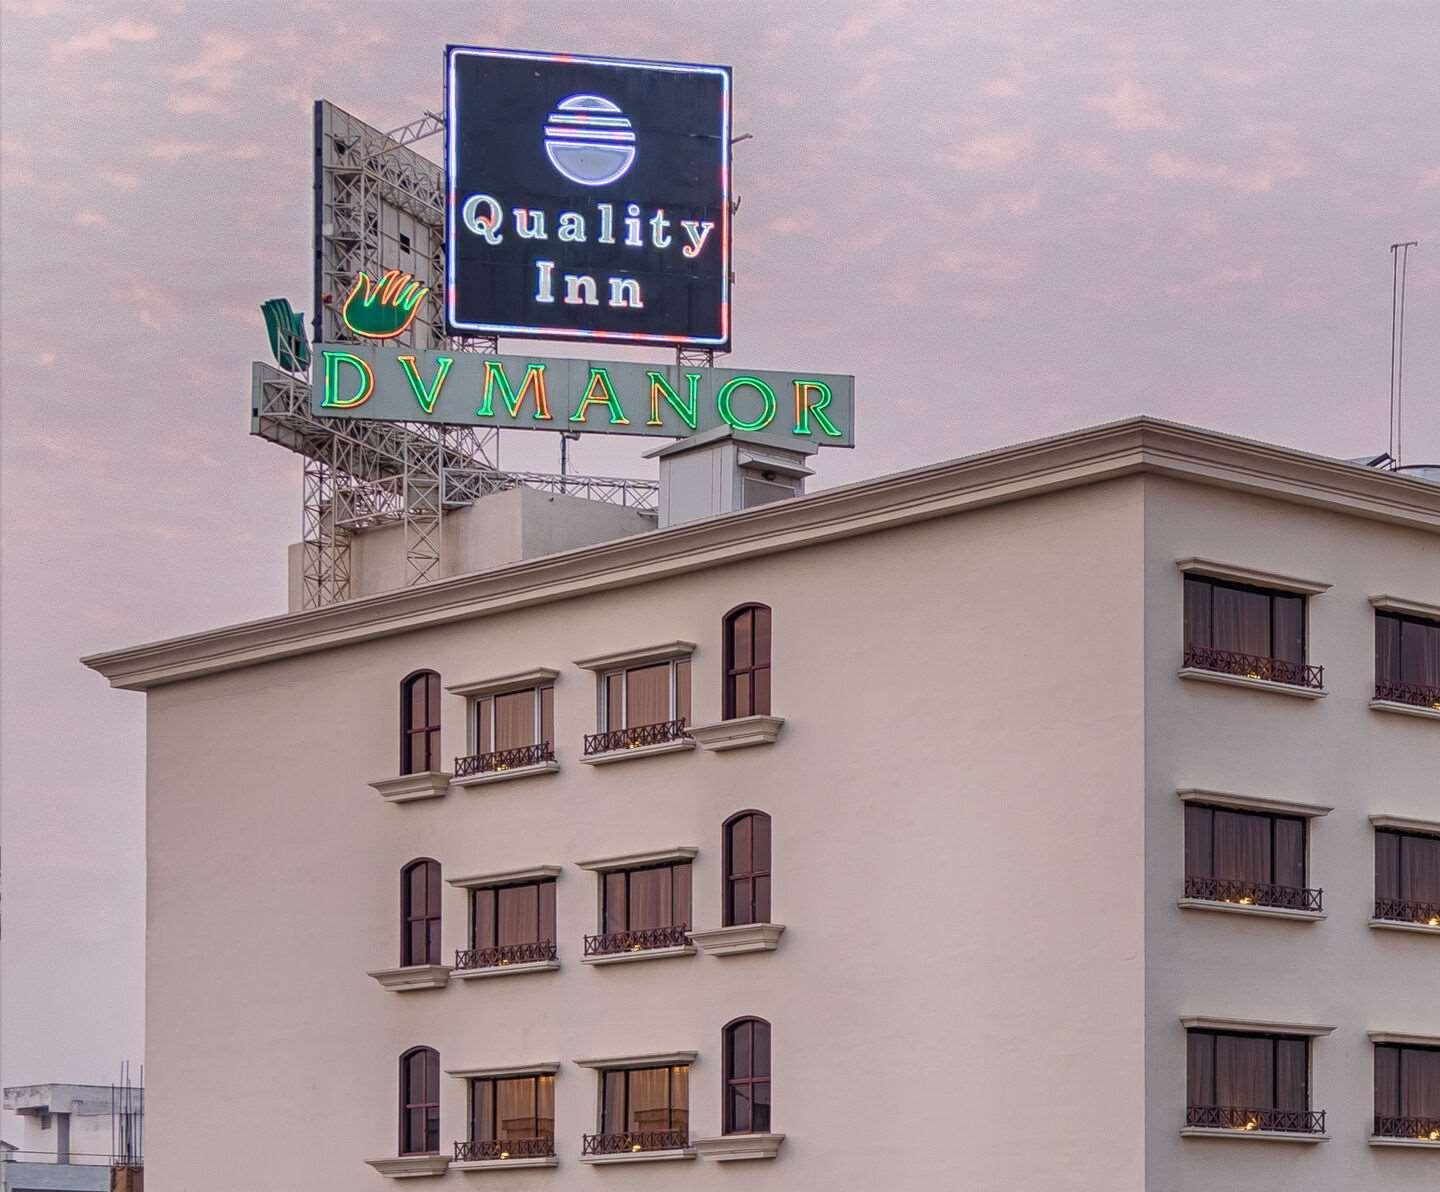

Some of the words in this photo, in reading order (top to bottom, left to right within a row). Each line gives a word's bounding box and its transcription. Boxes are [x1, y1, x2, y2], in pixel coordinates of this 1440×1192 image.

[462, 194, 714, 257] Quality
[535, 261, 644, 308] Inn
[475, 360, 842, 437] MANOR
